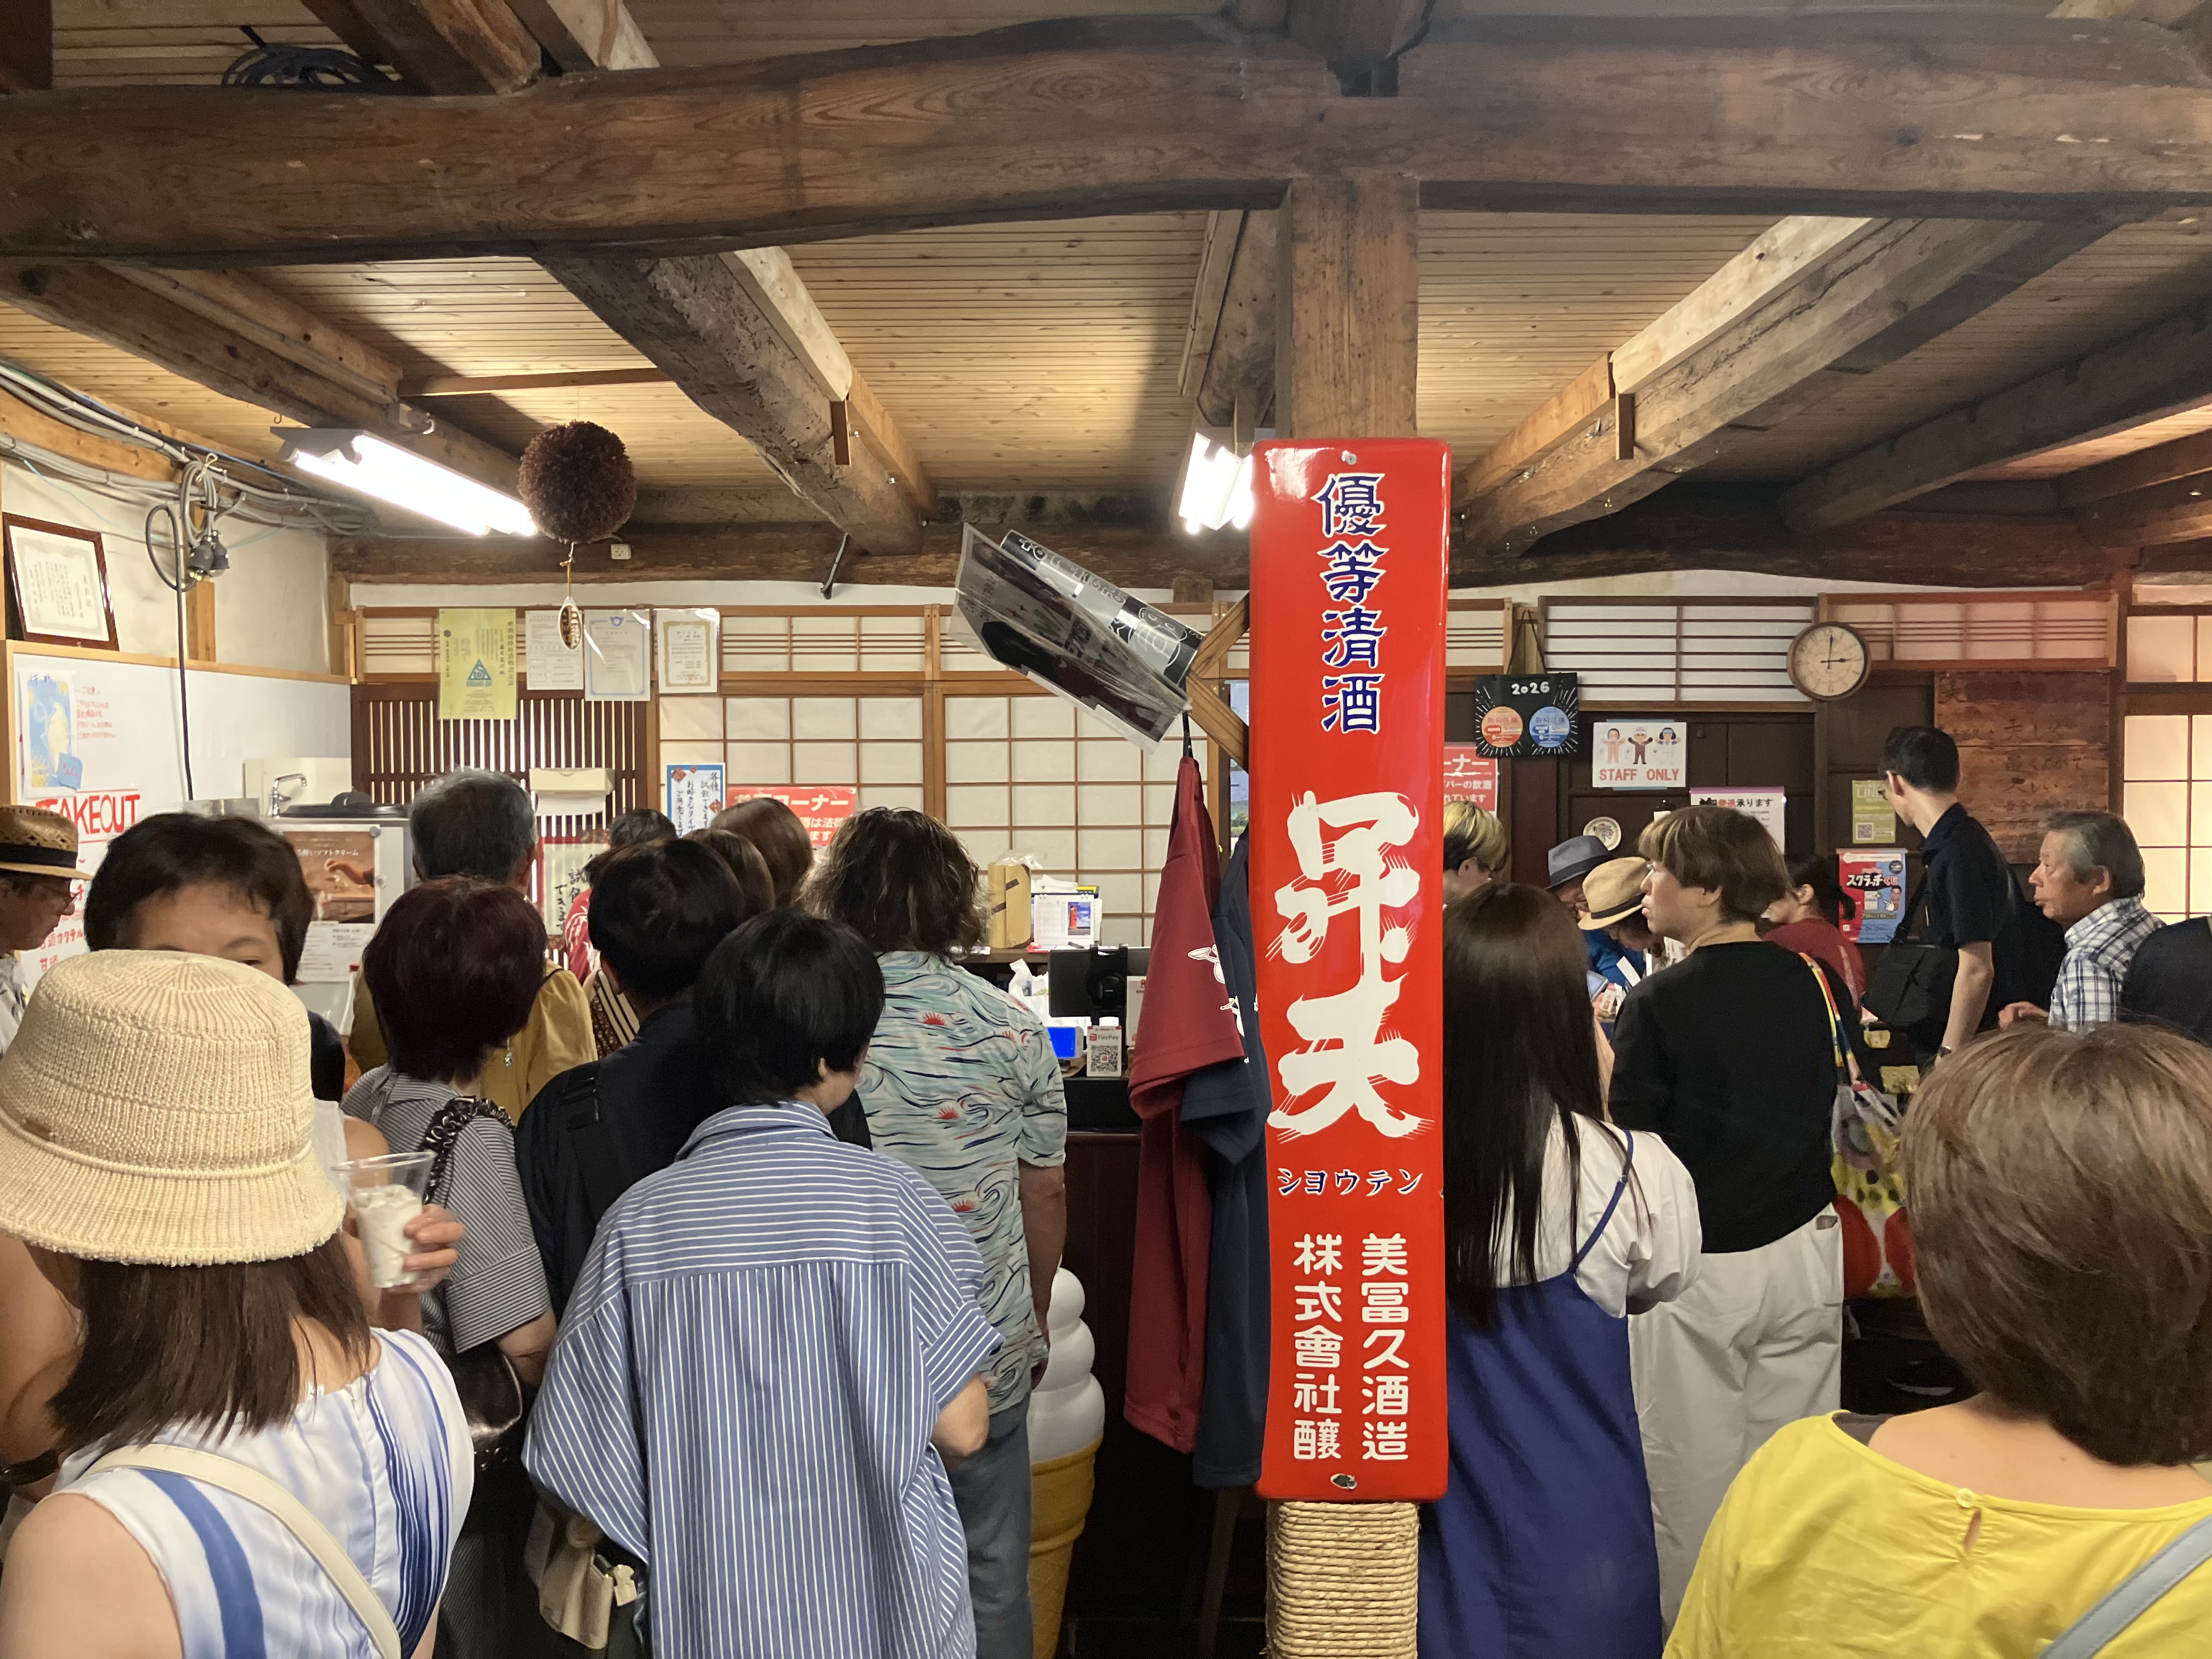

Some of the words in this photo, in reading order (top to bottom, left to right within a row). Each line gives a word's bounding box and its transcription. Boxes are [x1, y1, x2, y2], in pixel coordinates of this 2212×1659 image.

[1311, 472, 1390, 735] 優等清酒
[1511, 681, 1550, 695] 2026
[1599, 768, 1638, 781] STAFF
[1646, 768, 1680, 781] ONLY
[1846, 874, 1899, 887] スクラッチくじ
[1277, 1167, 1423, 1196] ショウテン
